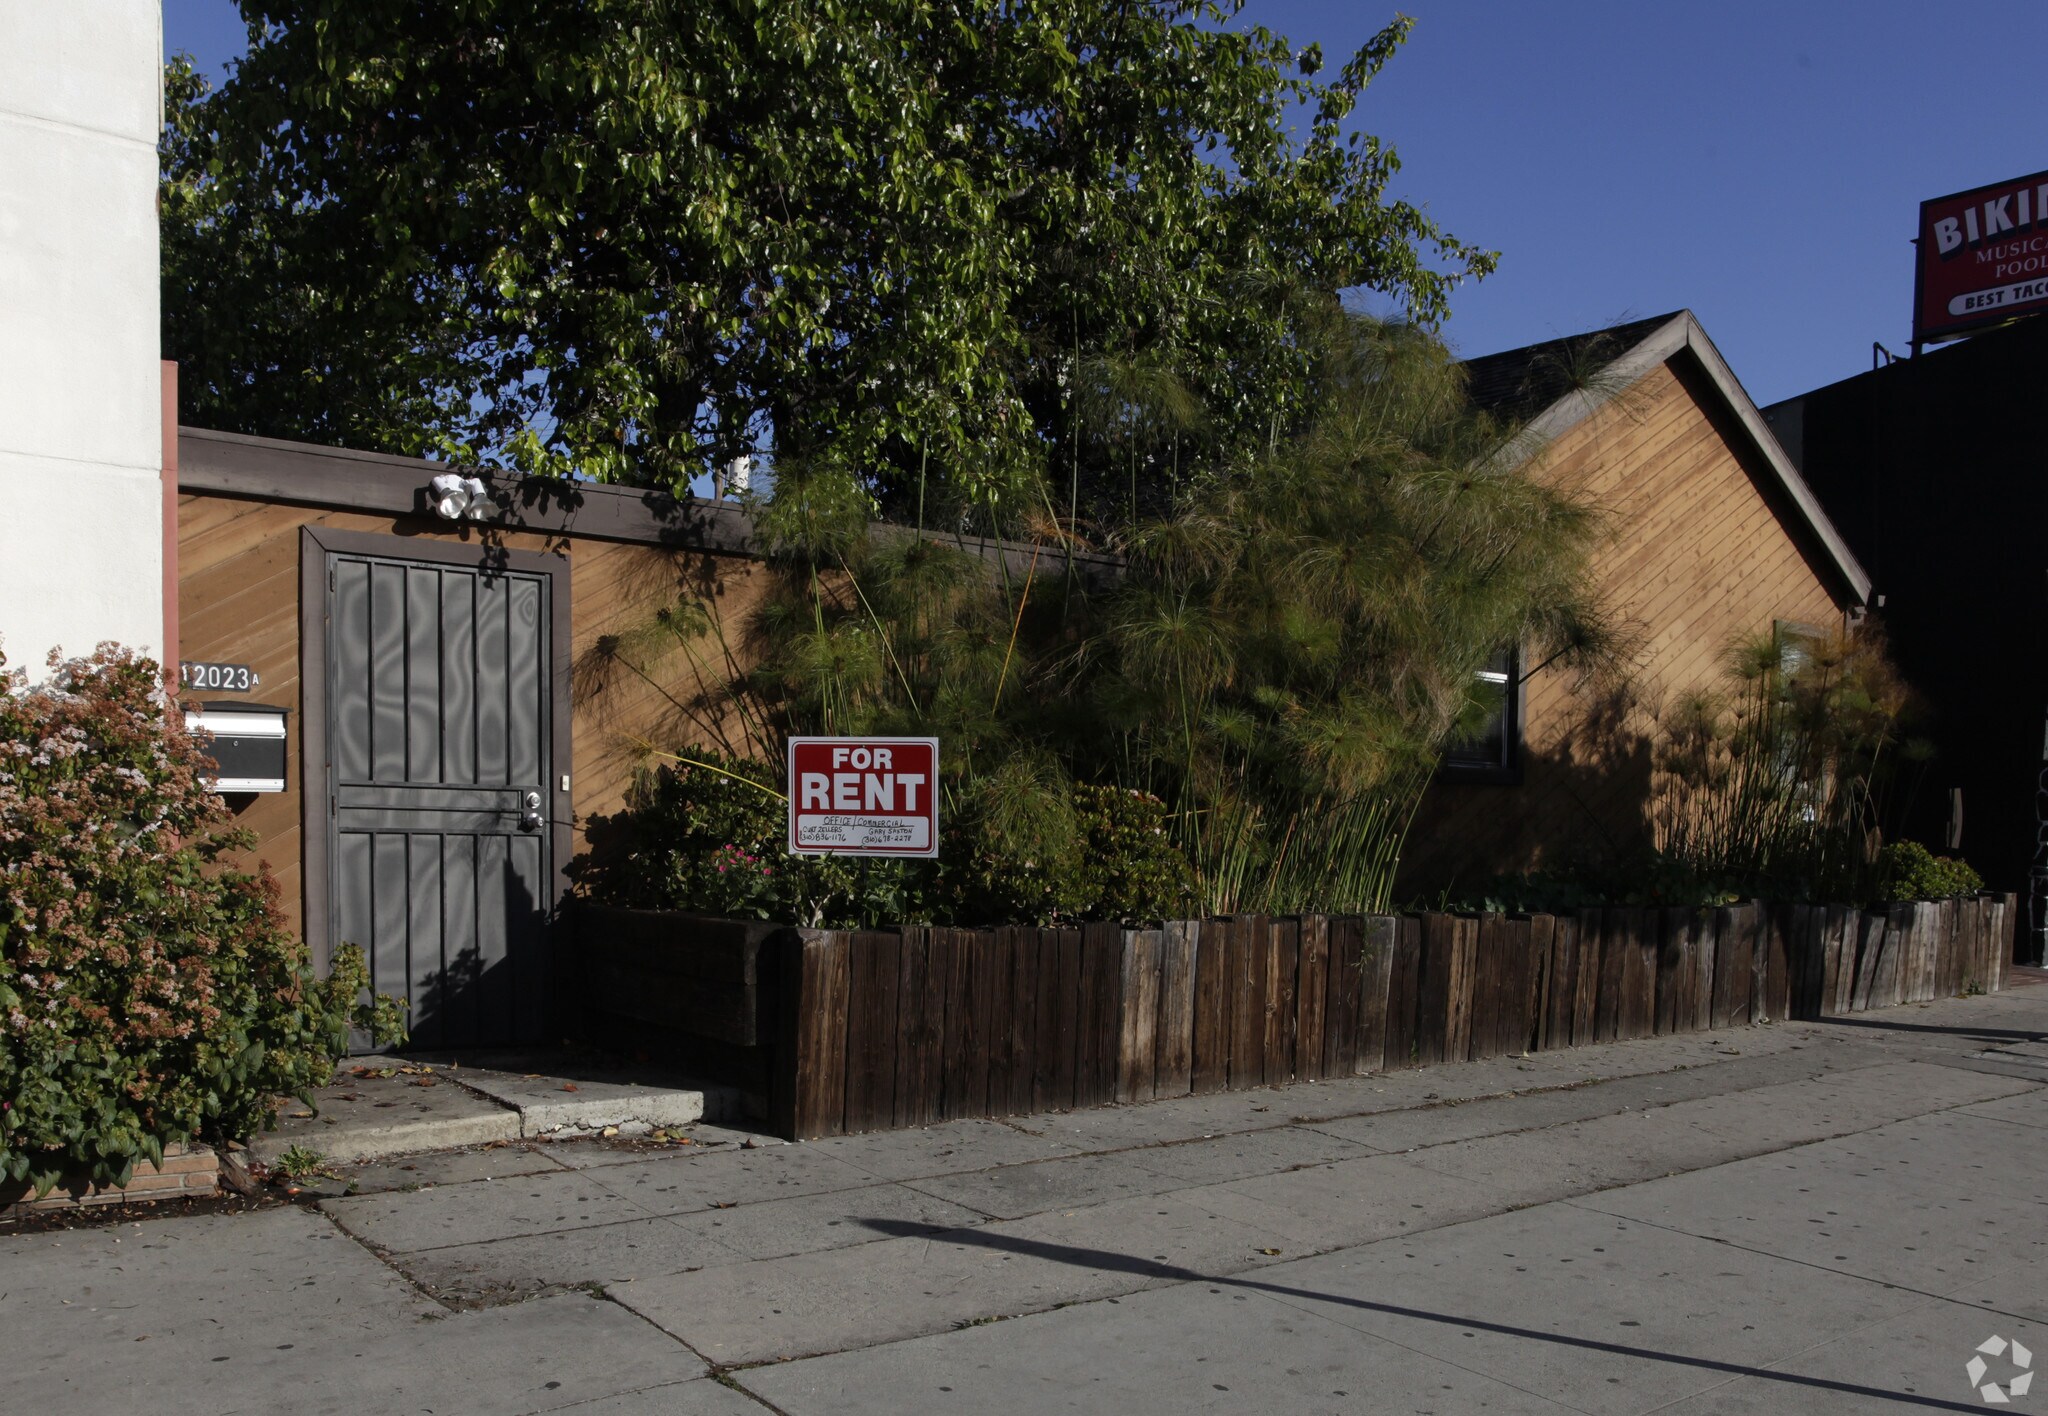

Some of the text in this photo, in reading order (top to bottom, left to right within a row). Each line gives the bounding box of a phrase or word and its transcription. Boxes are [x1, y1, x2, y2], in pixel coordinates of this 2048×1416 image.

[1976, 237, 2048, 264] MUSIC
[1965, 282, 2048, 310] BEST TAC
[832, 748, 892, 769] FOR
[801, 772, 925, 811] RENT
